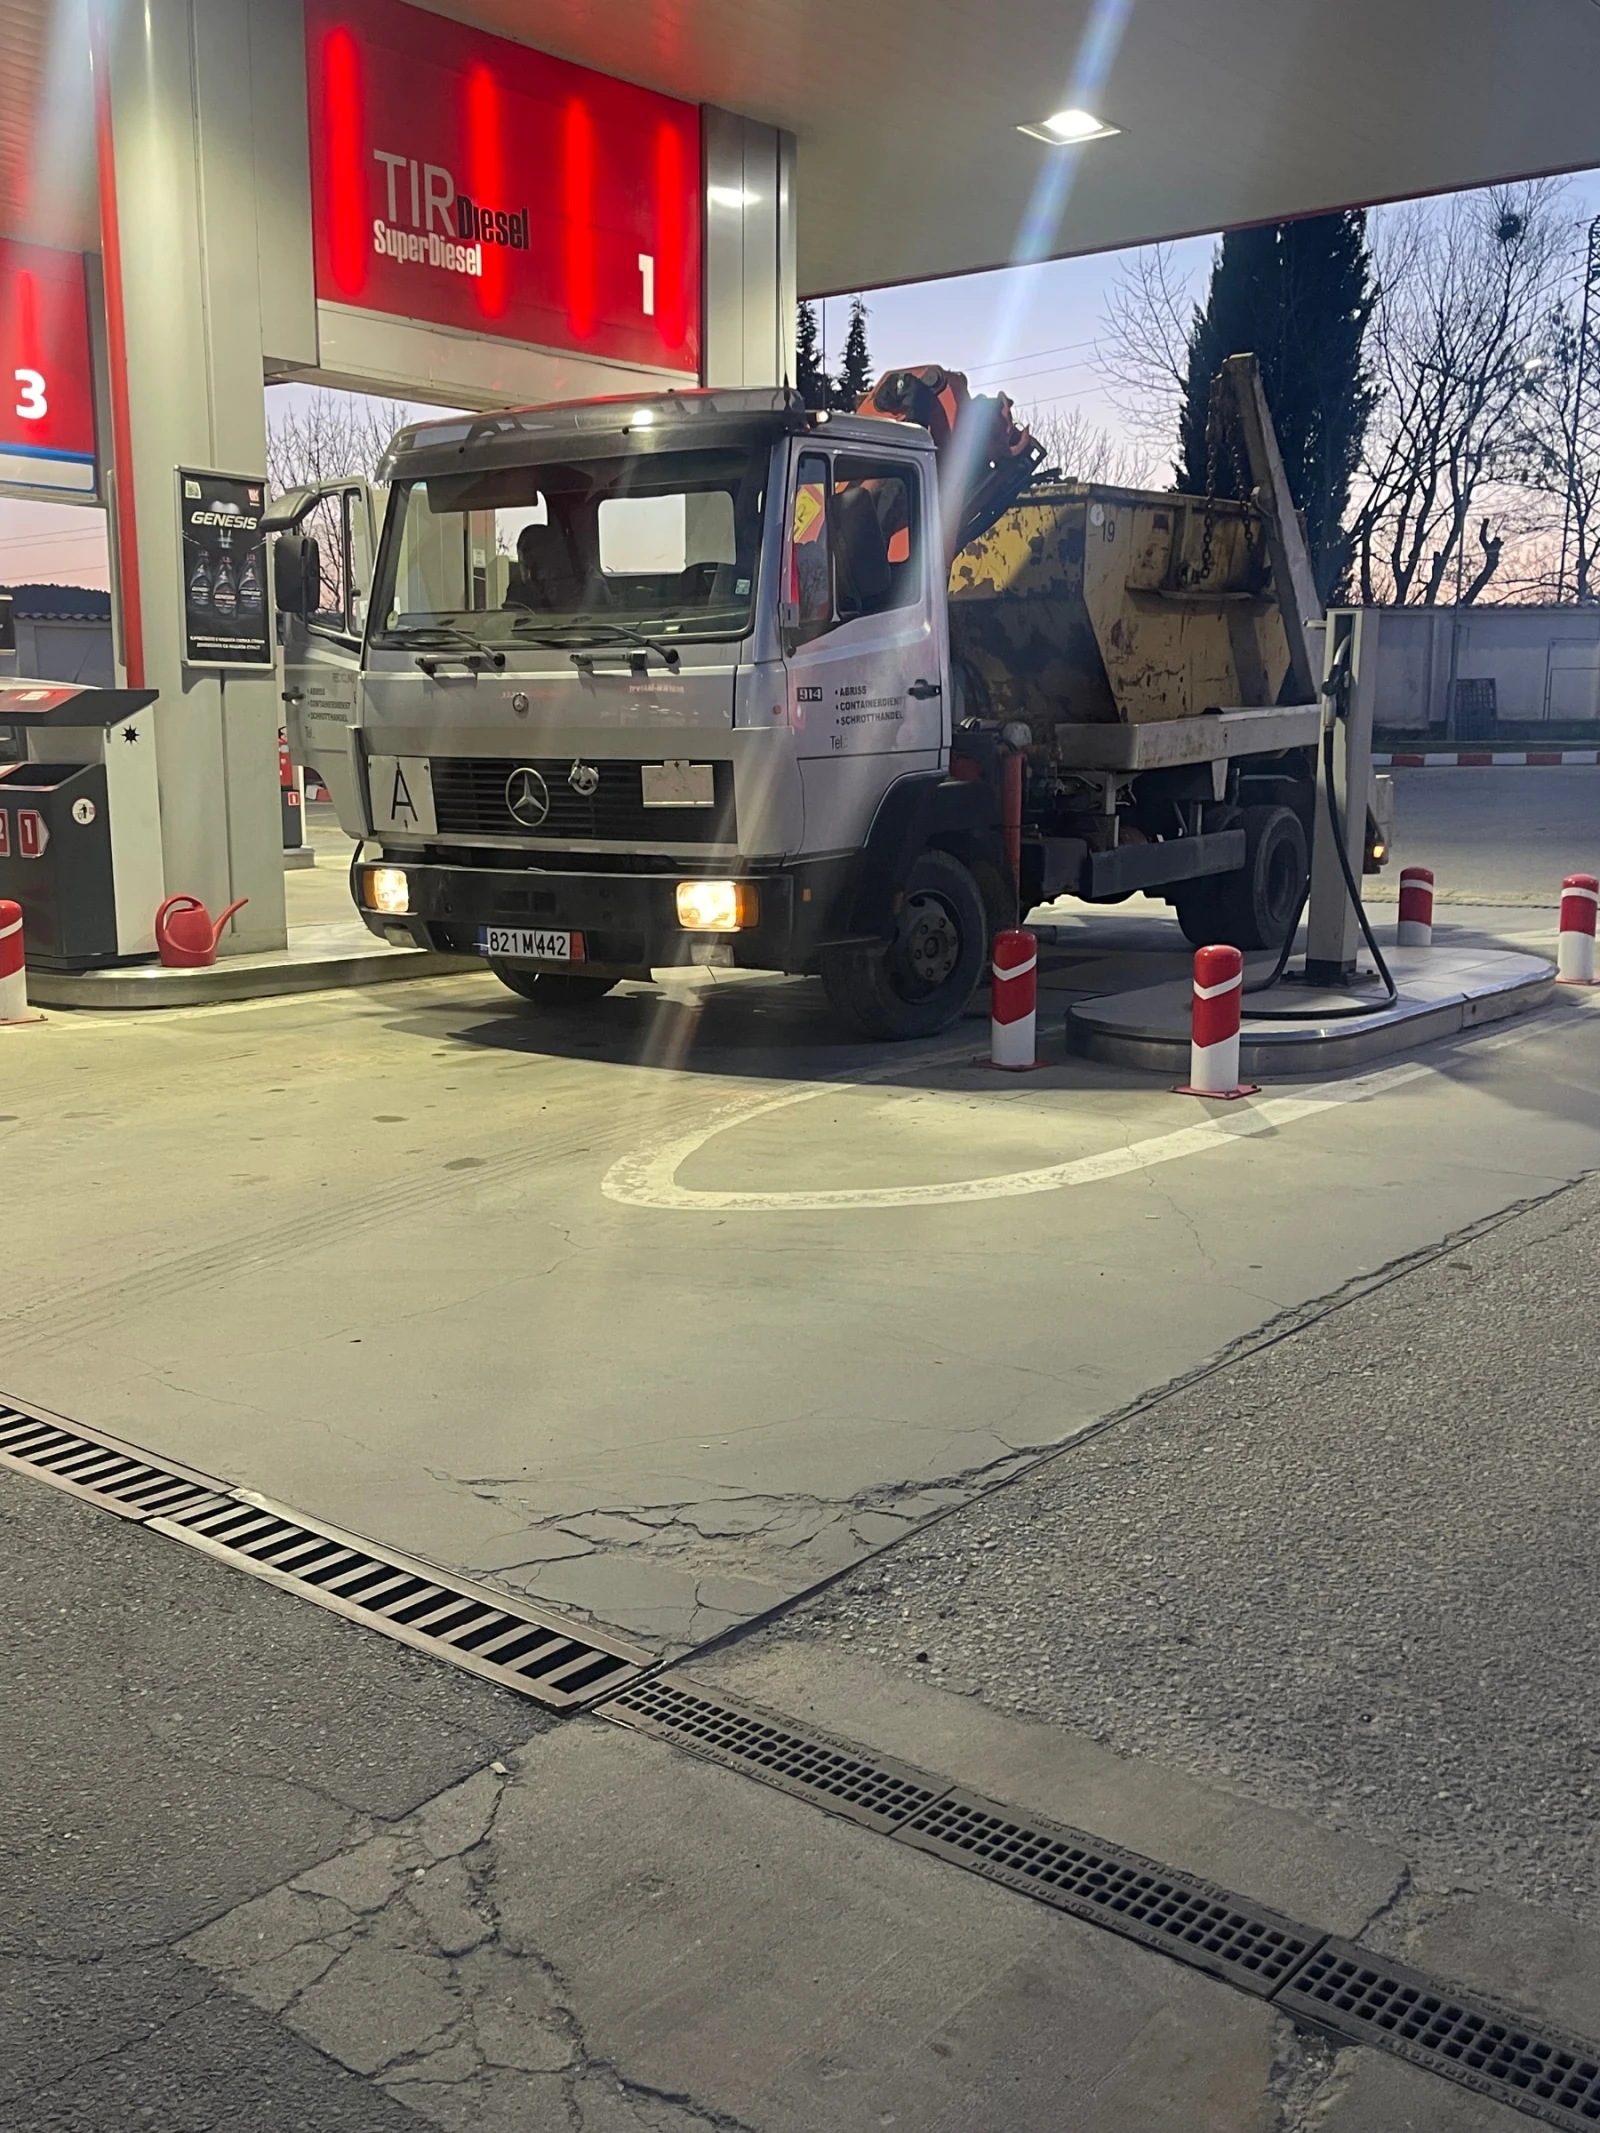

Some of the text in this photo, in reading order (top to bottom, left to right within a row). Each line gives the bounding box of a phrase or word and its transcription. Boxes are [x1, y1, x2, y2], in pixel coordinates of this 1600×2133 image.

[373, 149, 530, 250] TIR Diesel
[373, 219, 482, 277] SuperDiesel
[638, 253, 654, 316] 1
[14, 368, 48, 420] 3
[190, 511, 258, 530] GENESIS
[840, 686, 867, 697] ABRISS
[840, 696, 907, 712] CONTAINERDIENST
[841, 711, 904, 726] SCHROTTHANDEL
[391, 769, 418, 822] A
[23, 819, 33, 844] 1
